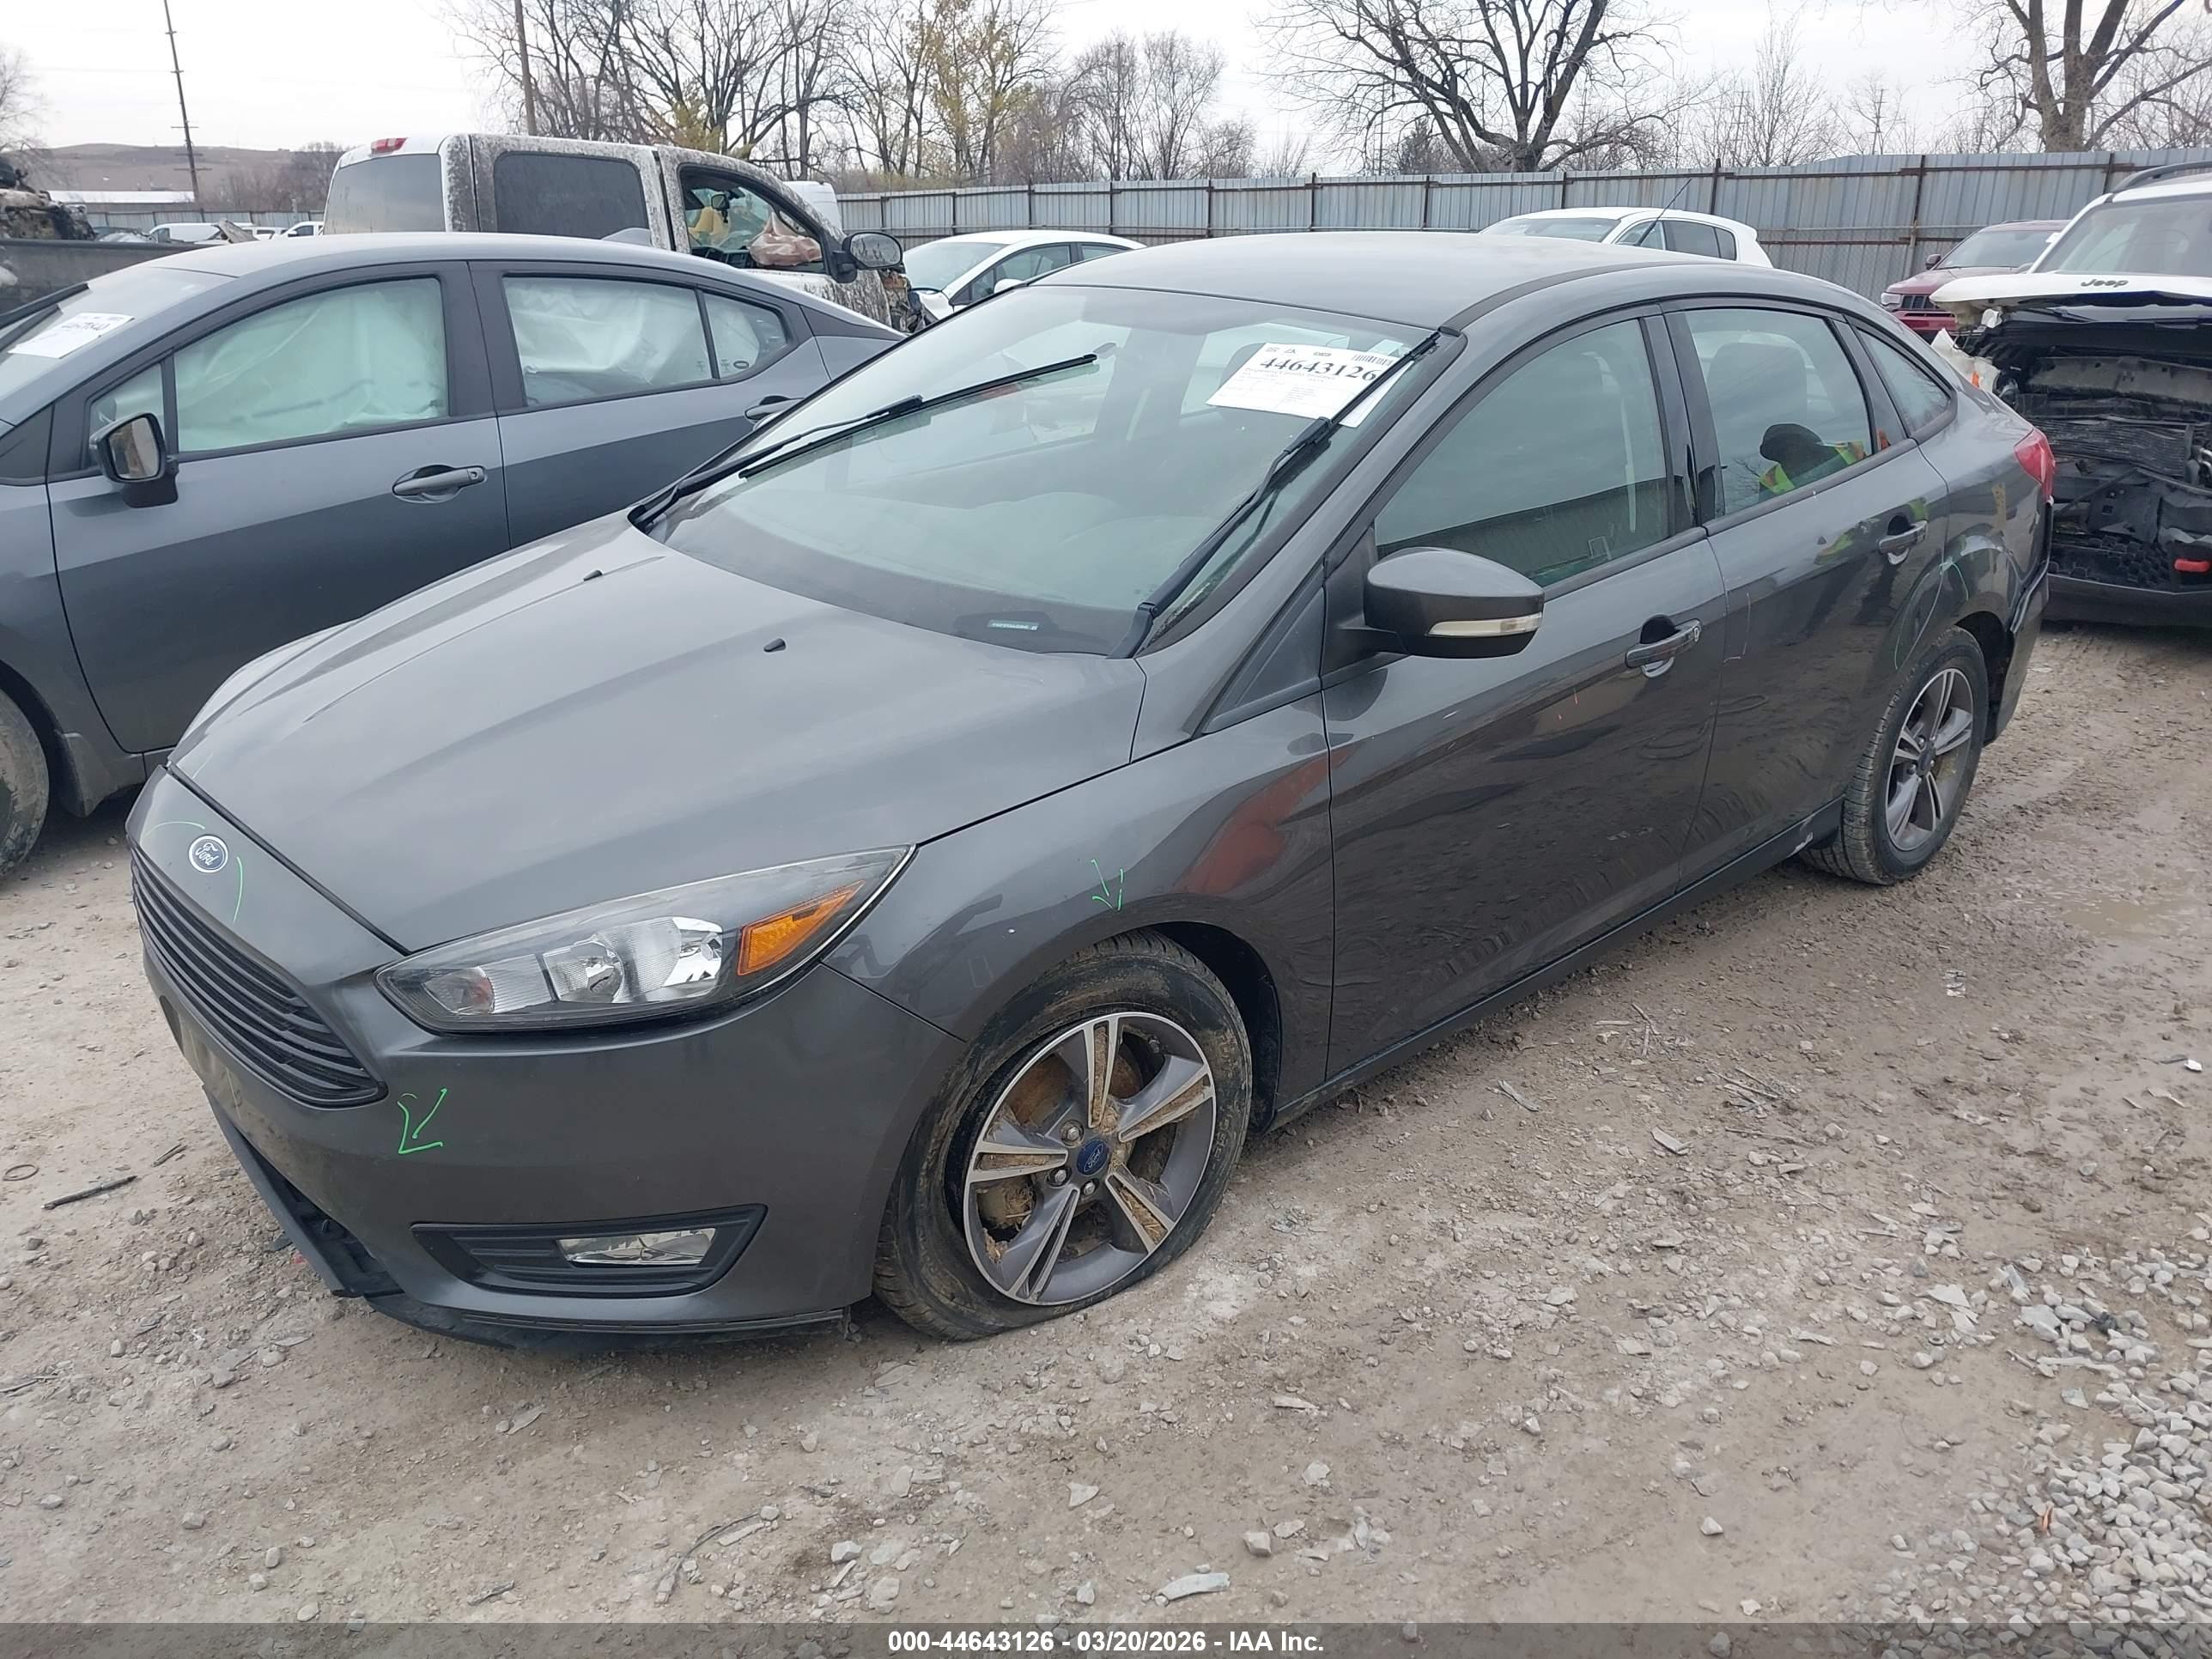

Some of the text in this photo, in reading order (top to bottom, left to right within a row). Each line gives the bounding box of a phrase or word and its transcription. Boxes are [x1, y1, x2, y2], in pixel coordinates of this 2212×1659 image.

[2081, 278, 2129, 289] Jeep
[1260, 357, 1381, 381] 44643126
[195, 842, 219, 866] Ford
